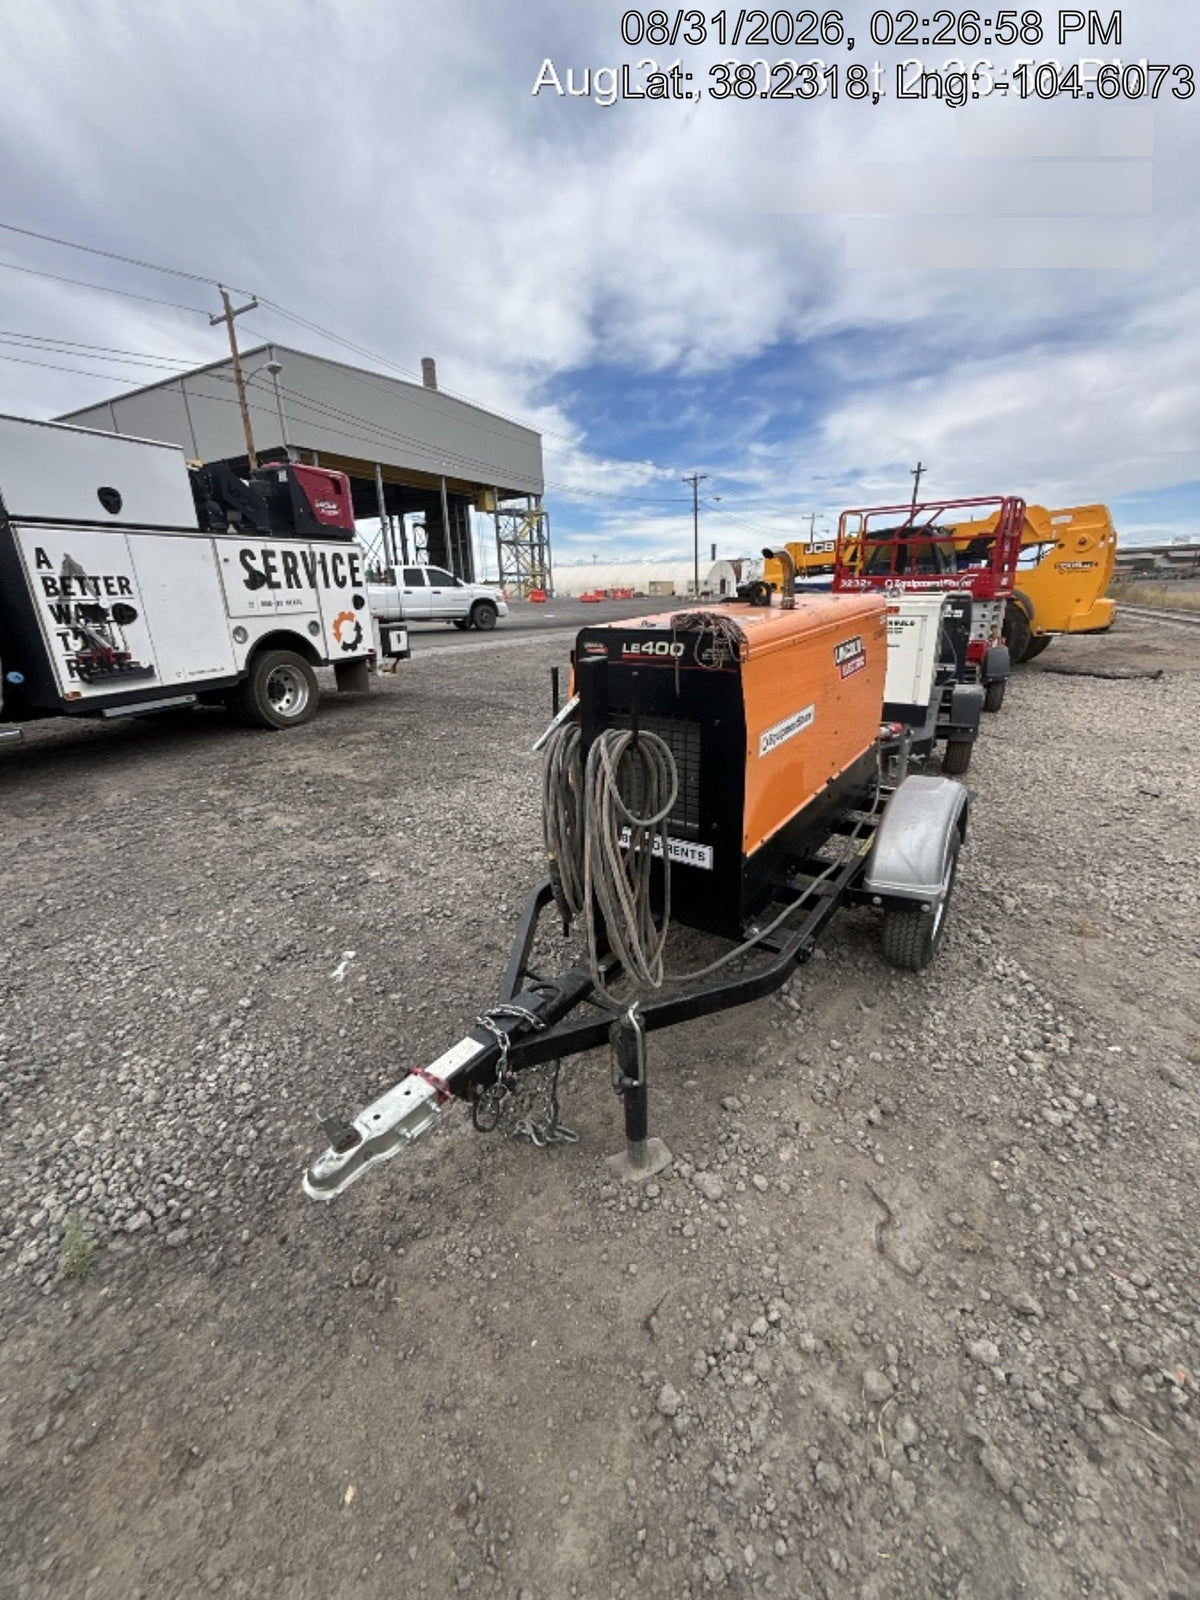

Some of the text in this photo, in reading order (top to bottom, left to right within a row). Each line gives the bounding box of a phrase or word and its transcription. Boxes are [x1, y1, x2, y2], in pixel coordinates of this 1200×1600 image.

[35, 547, 53, 569] A
[804, 542, 835, 554] JCB
[239, 549, 363, 590] SERVICE
[41, 575, 133, 597] BETTER
[622, 641, 685, 657] LE400
